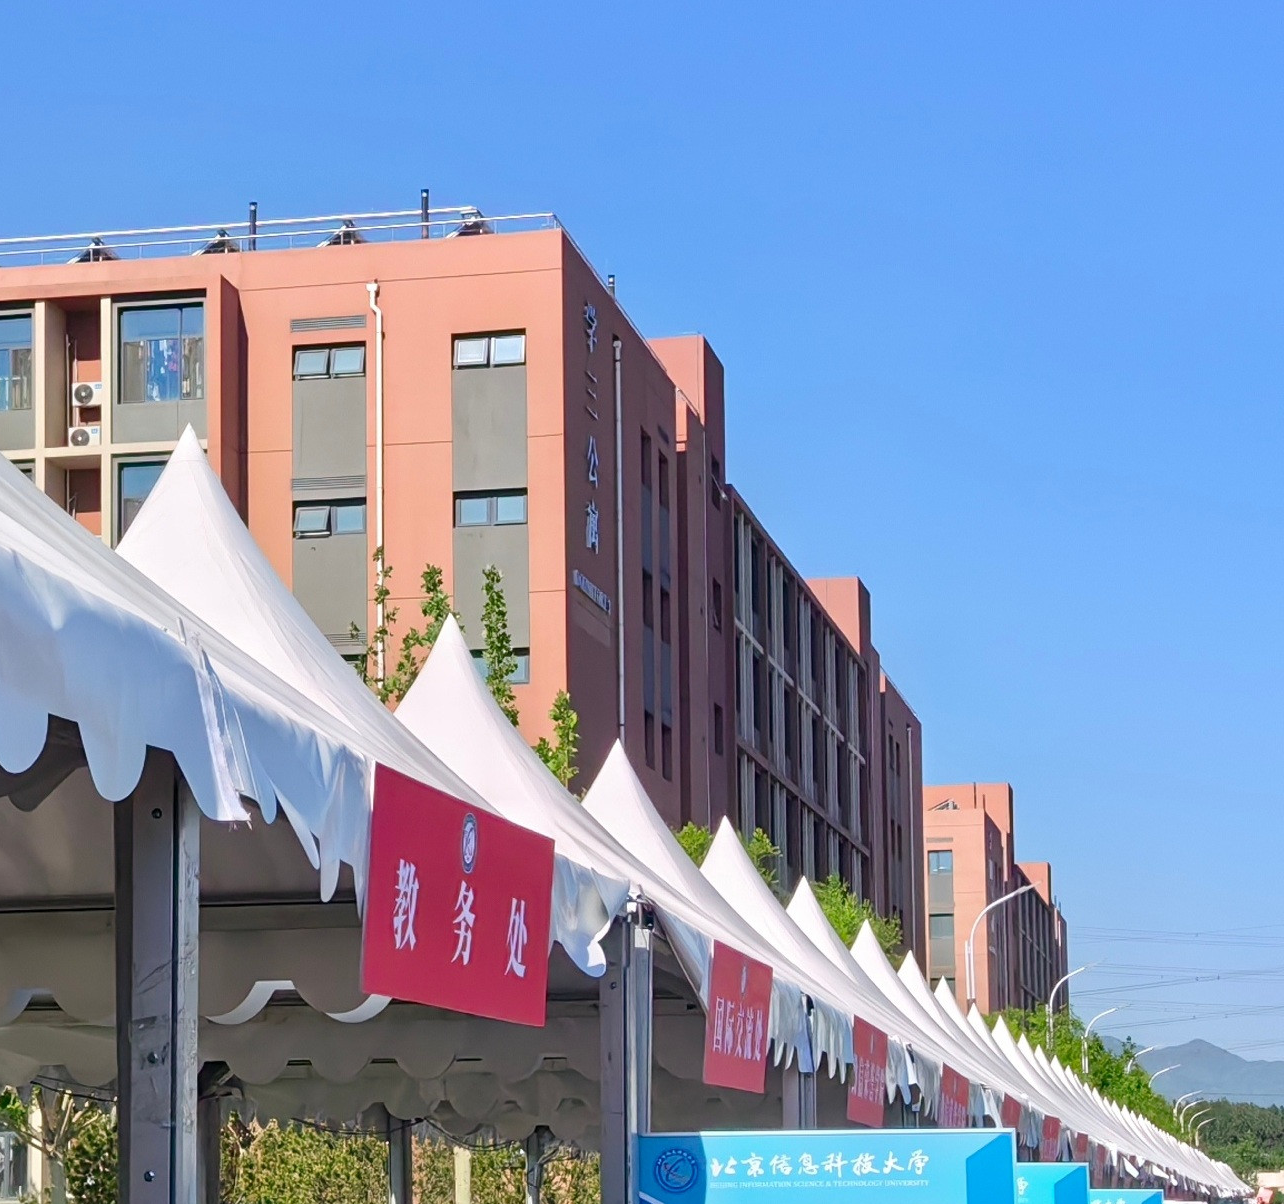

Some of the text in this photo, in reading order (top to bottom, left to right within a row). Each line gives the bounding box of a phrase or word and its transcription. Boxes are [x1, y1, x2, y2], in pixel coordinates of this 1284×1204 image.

[392, 857, 529, 978] 教务处
[712, 995, 765, 1062] 国际交流处
[709, 1149, 930, 1178] 北京信息科技大学
